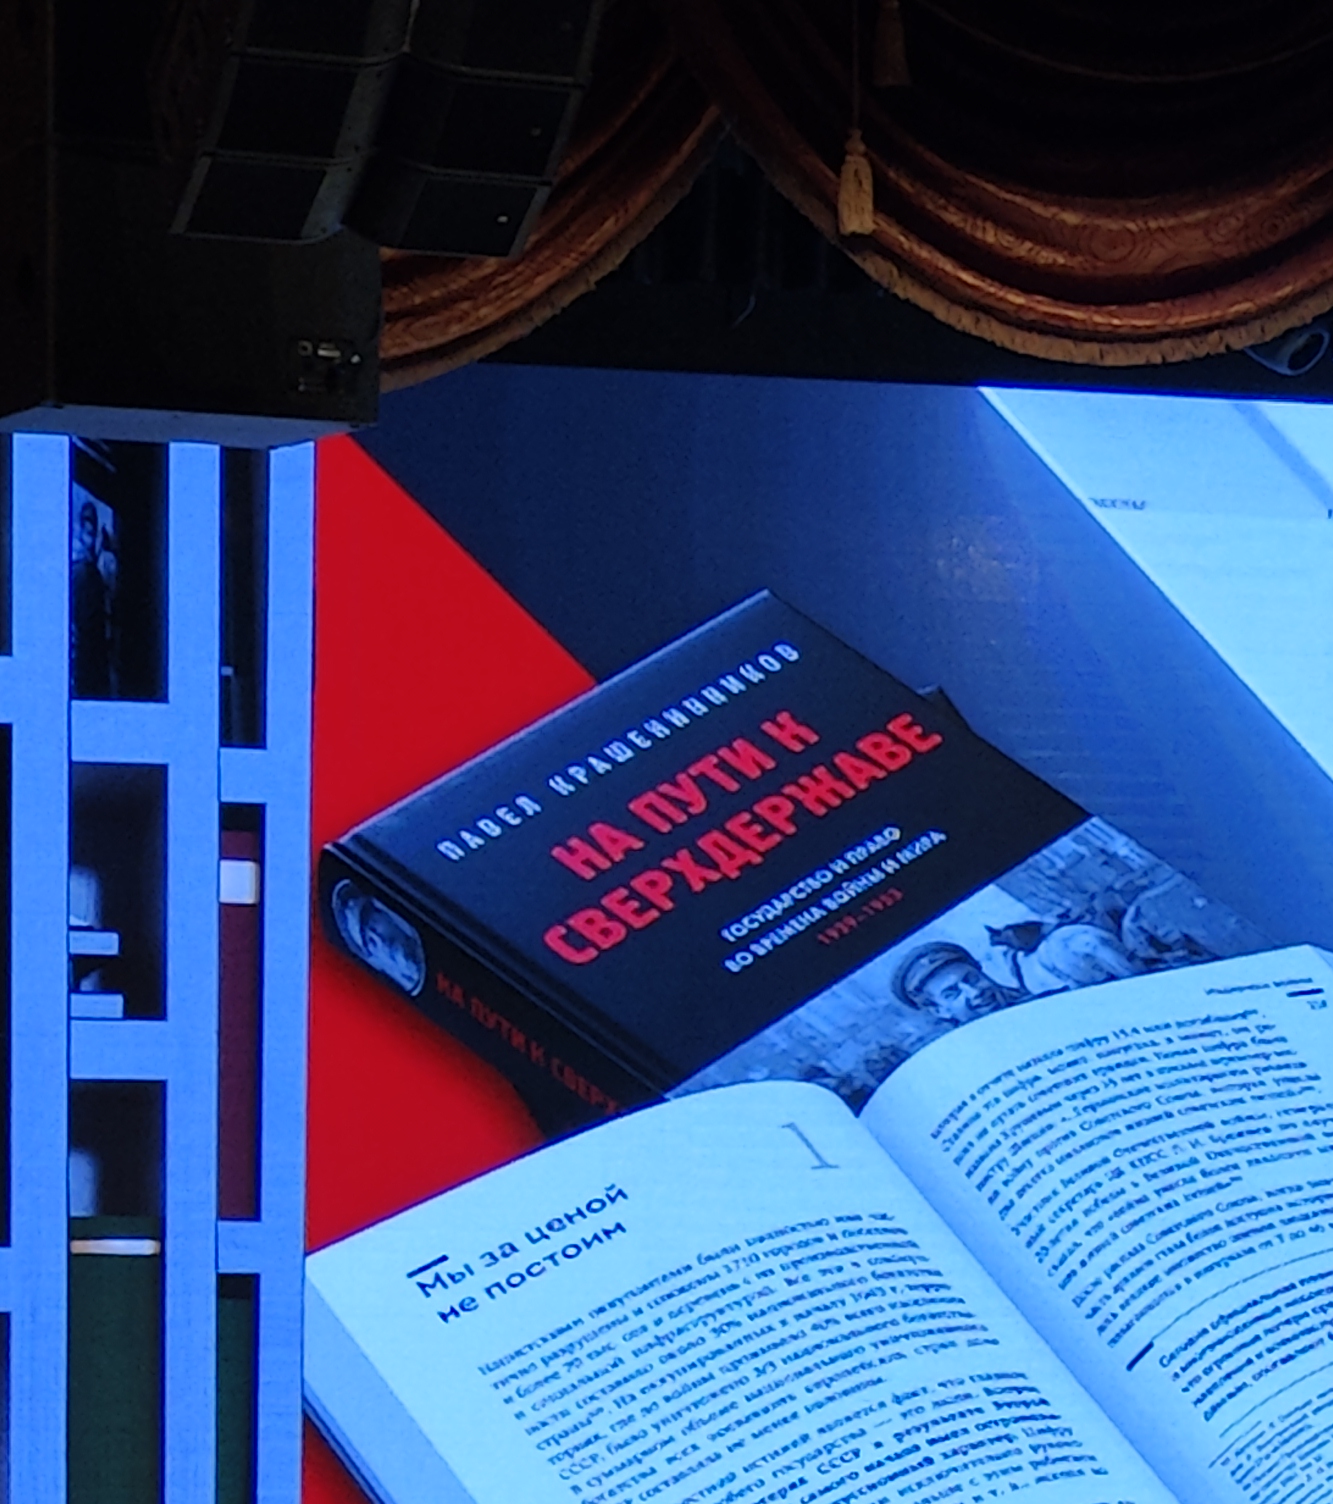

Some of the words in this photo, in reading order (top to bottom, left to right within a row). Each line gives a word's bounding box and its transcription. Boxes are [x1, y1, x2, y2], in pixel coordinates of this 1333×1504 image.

[437, 795, 541, 862] ПАВЕЛ
[549, 641, 800, 797] КРАШЕНИННИКОВ
[551, 822, 645, 880] НА
[628, 737, 777, 834] ПУТИ
[761, 710, 820, 753] К
[543, 712, 943, 965] СВЕРХДЕРЖАВЕ
[415, 1263, 475, 1299] Мы
[481, 1241, 519, 1268] за
[525, 1184, 629, 1245] ценой
[437, 1292, 480, 1324] не
[484, 1222, 628, 1299] постоим
